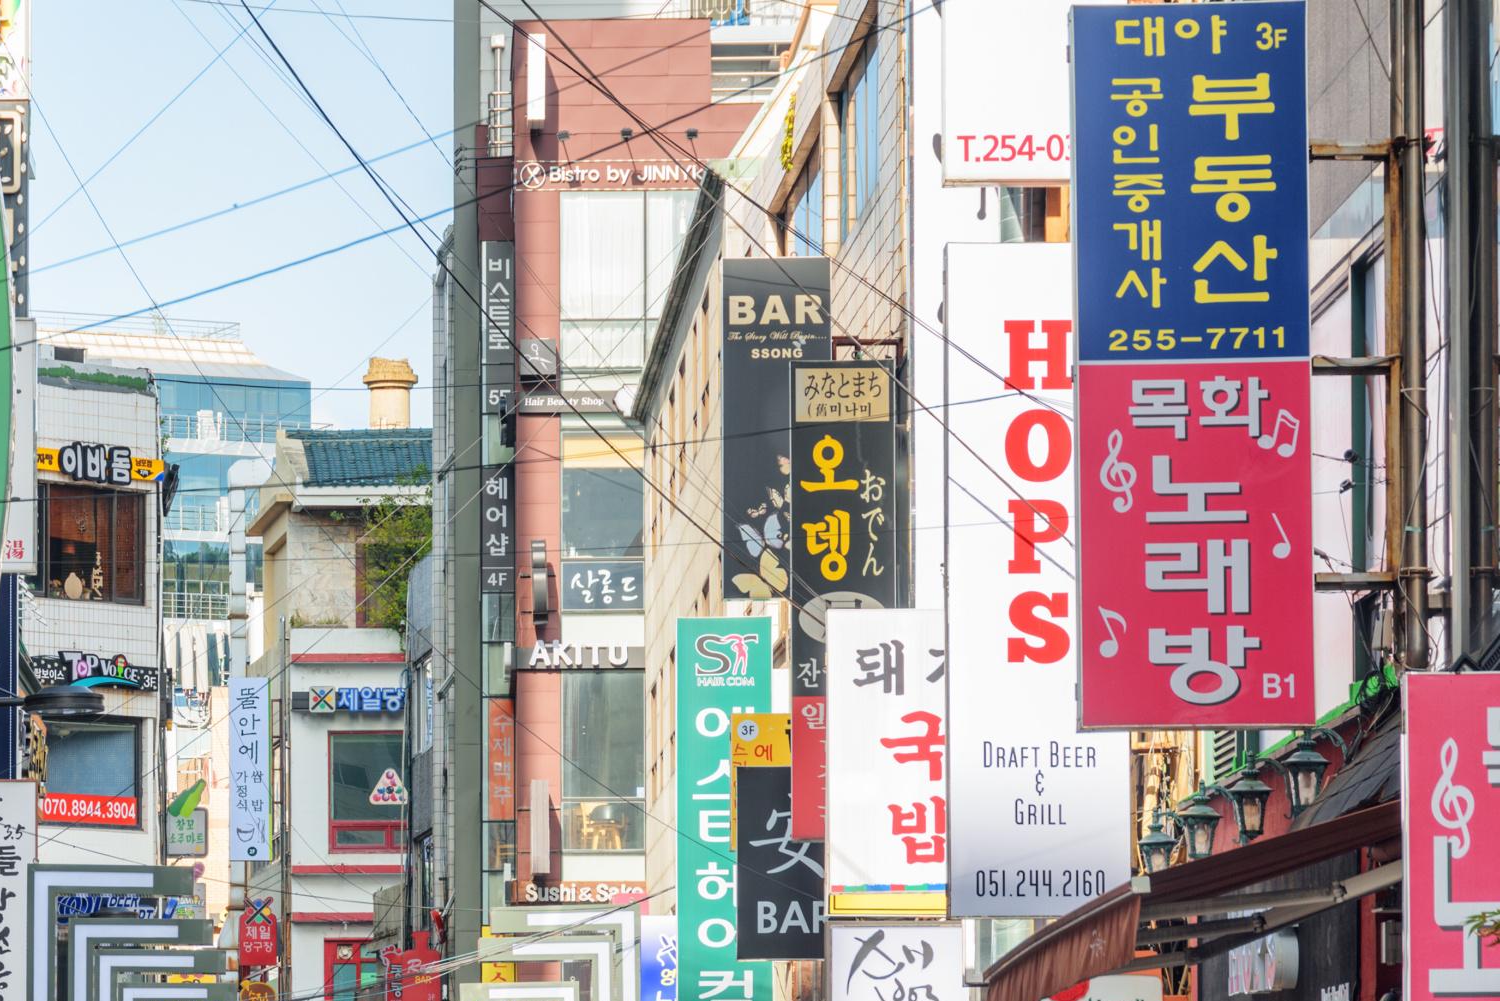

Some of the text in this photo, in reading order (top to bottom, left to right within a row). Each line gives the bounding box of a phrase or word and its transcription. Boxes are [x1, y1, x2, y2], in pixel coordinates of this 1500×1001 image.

[1114, 14, 1288, 57] 대야 3F
[548, 165, 600, 182] Bistro
[606, 165, 630, 184] by
[1188, 72, 1279, 304] 부동산
[1110, 77, 1168, 309] 공인중개사
[487, 256, 511, 351] 비스트로
[728, 295, 824, 326] BAR
[1108, 325, 1286, 352] 255-7711
[750, 347, 804, 360] SSONG
[803, 371, 883, 400] みなとまち
[524, 395, 605, 409] Hair Beauty Shop
[1128, 375, 1270, 440] 목화
[61, 444, 132, 485] 이바돔
[1003, 318, 1073, 665] HOPS
[485, 478, 509, 558] 헤어샵
[799, 434, 860, 582] 오뎅
[859, 469, 887, 578] おでん
[487, 572, 508, 586] 4F
[570, 568, 639, 605] 살롱드
[1144, 455, 1261, 706] 노래방
[528, 640, 629, 668] AKITU
[143, 674, 157, 688] 3F
[1262, 673, 1297, 700] B1
[741, 725, 755, 736] 3F
[491, 714, 513, 806] 수제맥주
[1034, 769, 1046, 796] &
[43, 796, 136, 822] 070.8944.3904
[525, 883, 577, 904] Sushi
[579, 885, 594, 903] &
[975, 869, 1107, 898] 051.244.2160
[244, 925, 272, 940] 제일
